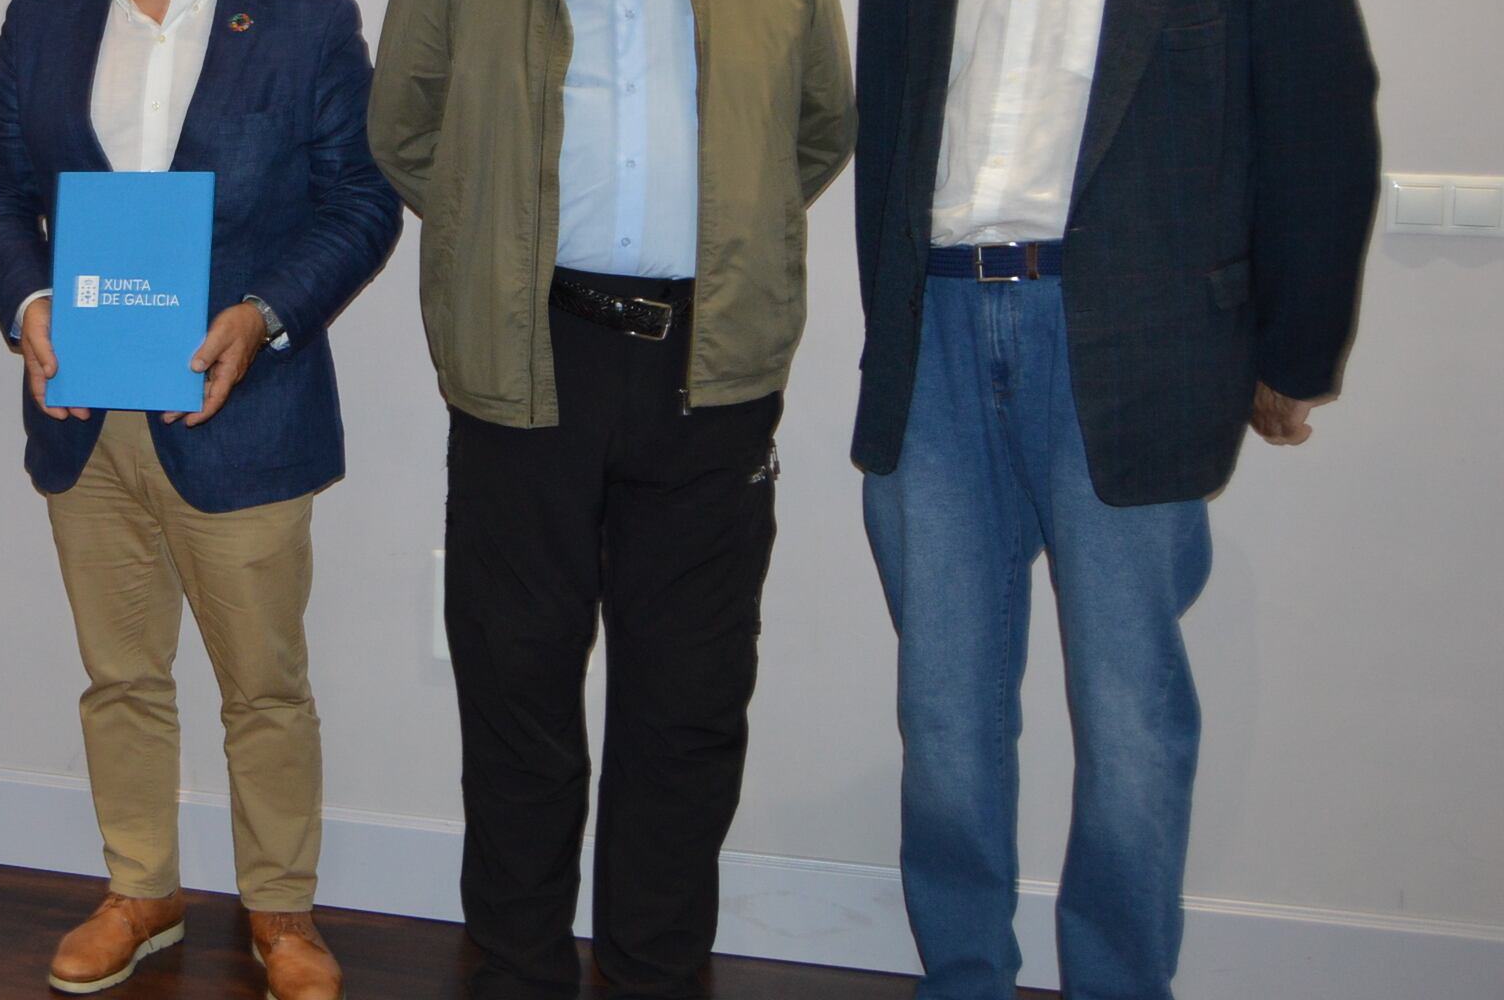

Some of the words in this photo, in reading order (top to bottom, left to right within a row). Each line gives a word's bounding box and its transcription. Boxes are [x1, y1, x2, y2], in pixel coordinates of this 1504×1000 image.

[103, 279, 151, 291] XUNTA
[102, 293, 120, 306] DE
[124, 293, 180, 307] GALICIA
